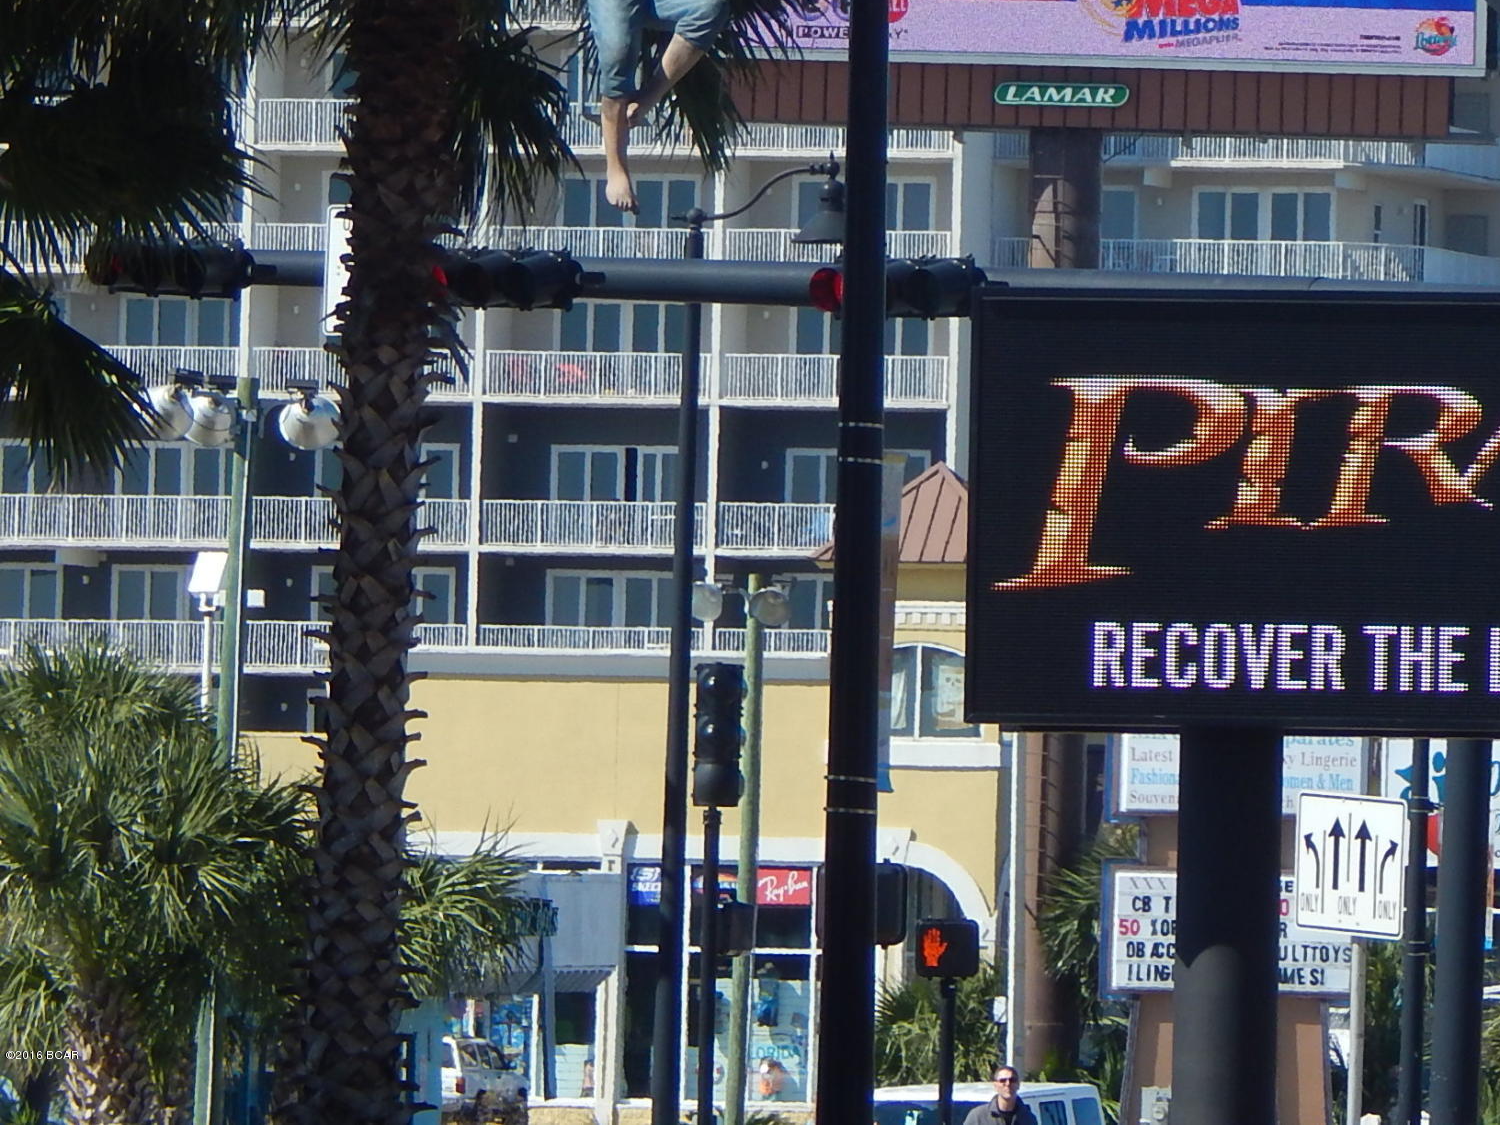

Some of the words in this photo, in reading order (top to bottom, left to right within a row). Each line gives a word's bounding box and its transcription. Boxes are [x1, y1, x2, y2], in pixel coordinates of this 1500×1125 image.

[1123, 16, 1240, 44] MILLIONS
[1005, 85, 1116, 104] LAMAR
[1090, 621, 1346, 690] RECOVER
[1363, 625, 1469, 694] THE
[1131, 747, 1173, 762] Latest
[1301, 751, 1358, 771] Lingerie
[1131, 767, 1179, 785] Fashion
[1329, 773, 1354, 791] Men
[1129, 790, 1178, 804] Souven
[1300, 893, 1320, 912] ONLY
[1338, 896, 1357, 916] ONLY
[1377, 901, 1396, 920] ONLY
[1119, 919, 1141, 935] 50
